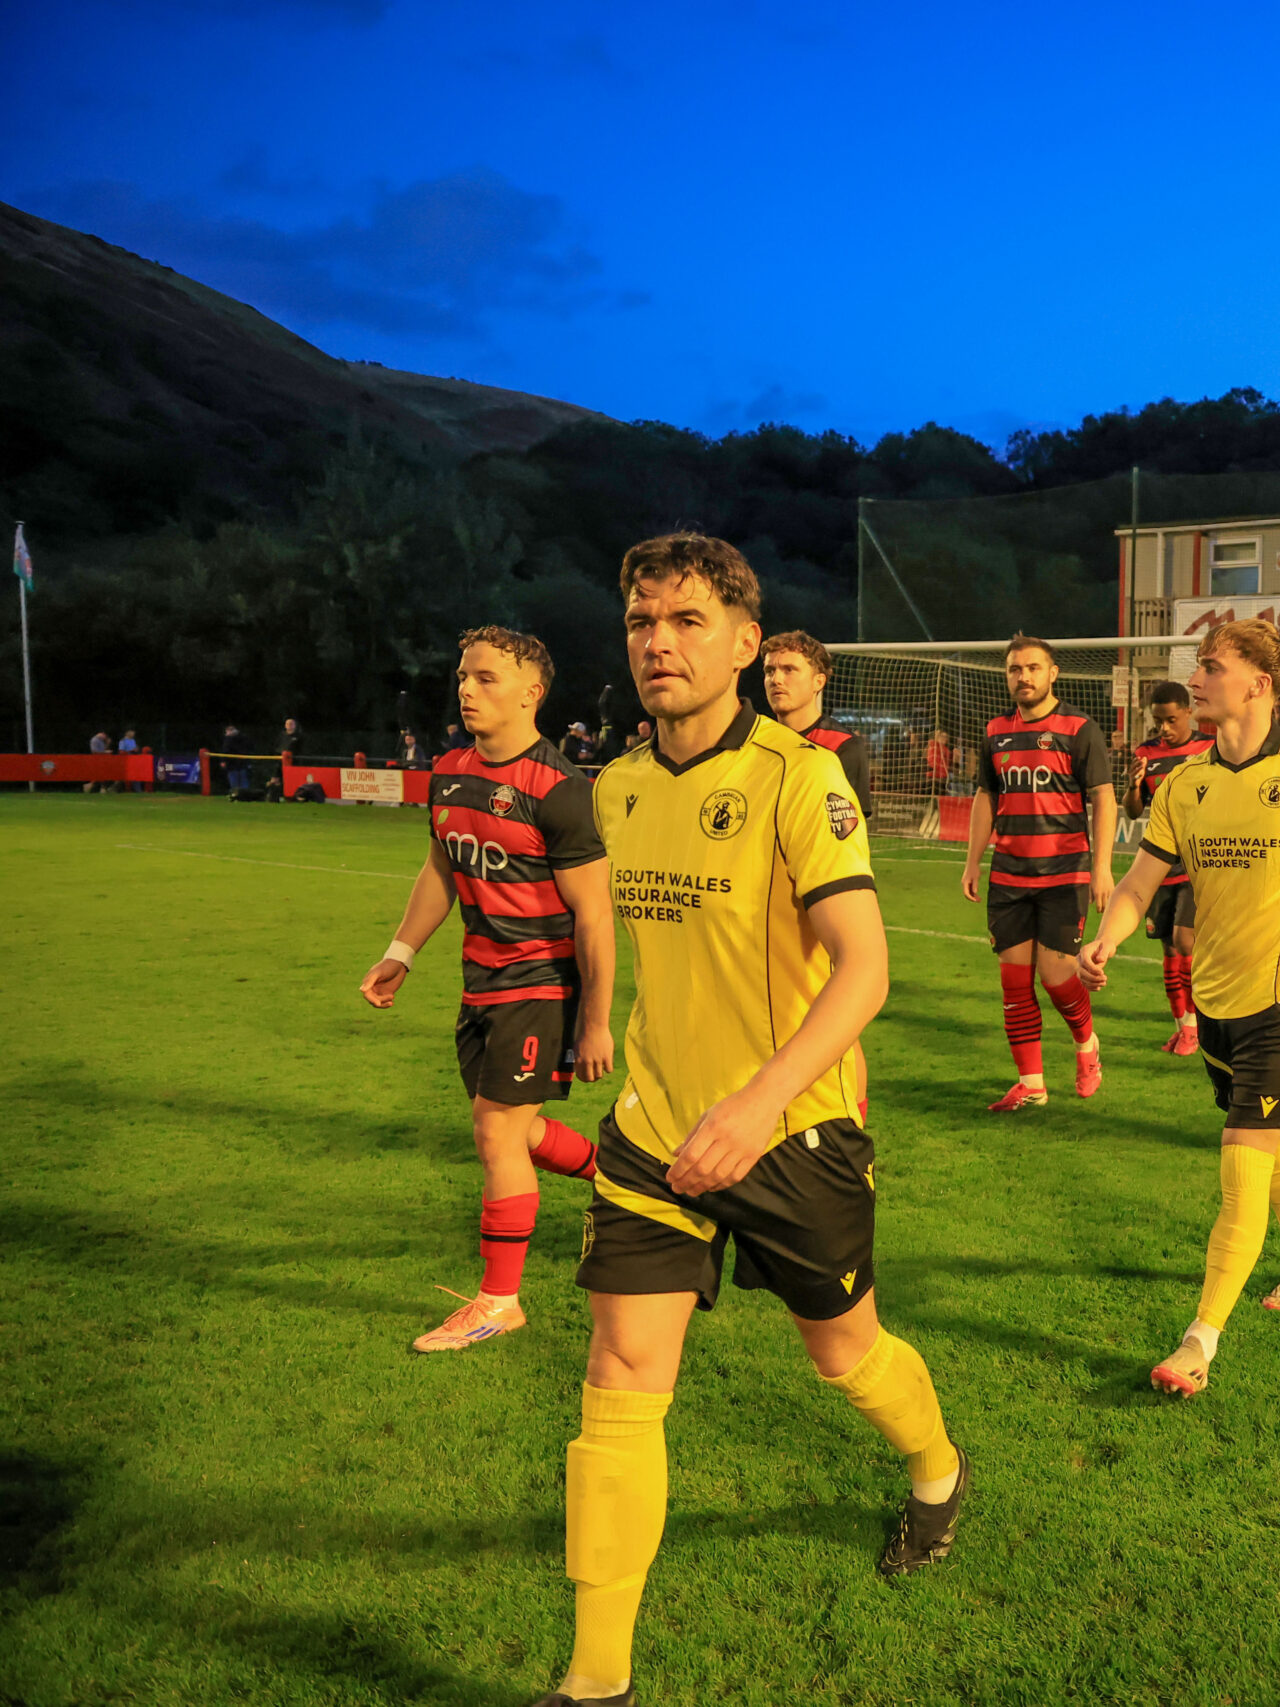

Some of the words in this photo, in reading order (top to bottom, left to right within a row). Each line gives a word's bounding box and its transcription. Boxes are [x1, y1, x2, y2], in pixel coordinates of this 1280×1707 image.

[358, 771, 375, 782] JOHN
[342, 783, 380, 794] SCAFFOLDING
[831, 822, 841, 833] TV
[1198, 837, 1237, 847] SOUTH
[1201, 848, 1267, 859] INSURANCE
[1202, 859, 1251, 869] BROKERS
[615, 869, 665, 885] SOUTH
[668, 872, 732, 893] WALES
[614, 887, 702, 909] INSURANCE
[616, 905, 683, 923] BROKERS
[520, 1035, 539, 1072] 9
